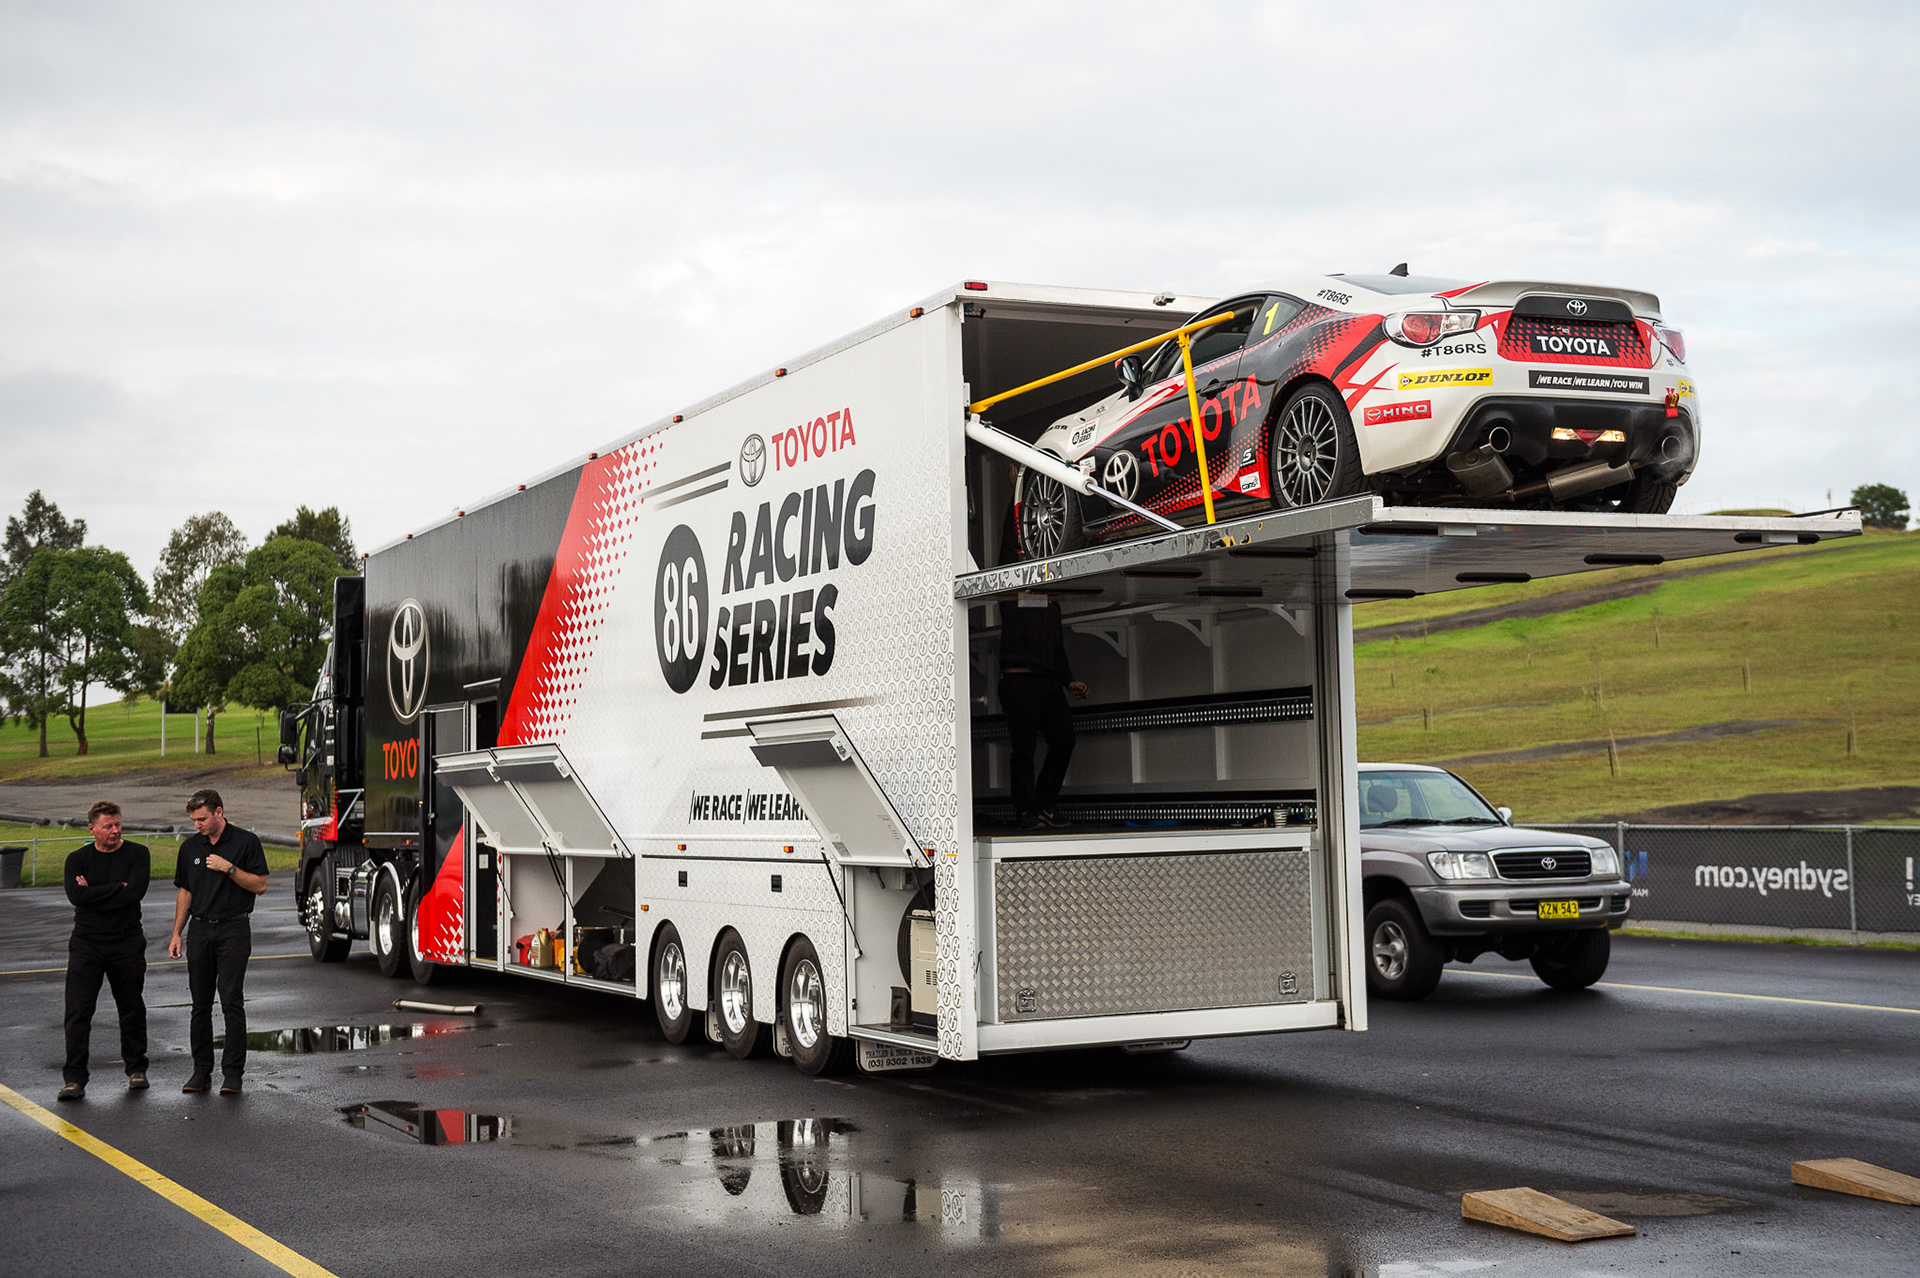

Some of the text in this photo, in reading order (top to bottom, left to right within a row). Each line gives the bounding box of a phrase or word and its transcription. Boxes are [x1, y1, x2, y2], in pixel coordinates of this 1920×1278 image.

[1316, 289, 1352, 305] #T86RS
[1262, 301, 1280, 336] 1
[1420, 343, 1487, 358] #T86RS
[1536, 335, 1611, 355] TOYOTA
[1414, 372, 1490, 385] DUNLOP
[1552, 376, 1572, 385] RACE
[1587, 378, 1610, 387] LEARN
[1628, 380, 1643, 390] WIN
[1383, 404, 1429, 417] HINO
[1141, 372, 1261, 478] TOYOTA
[772, 407, 856, 471] TOYOTA
[721, 468, 876, 595] RACING
[663, 556, 700, 664] 86
[709, 583, 839, 691] SERIES
[382, 737, 420, 780] TOYO
[711, 794, 742, 821] RACE
[1561, 902, 1577, 914] 543
[868, 1056, 932, 1069] (03) 9302 1939
